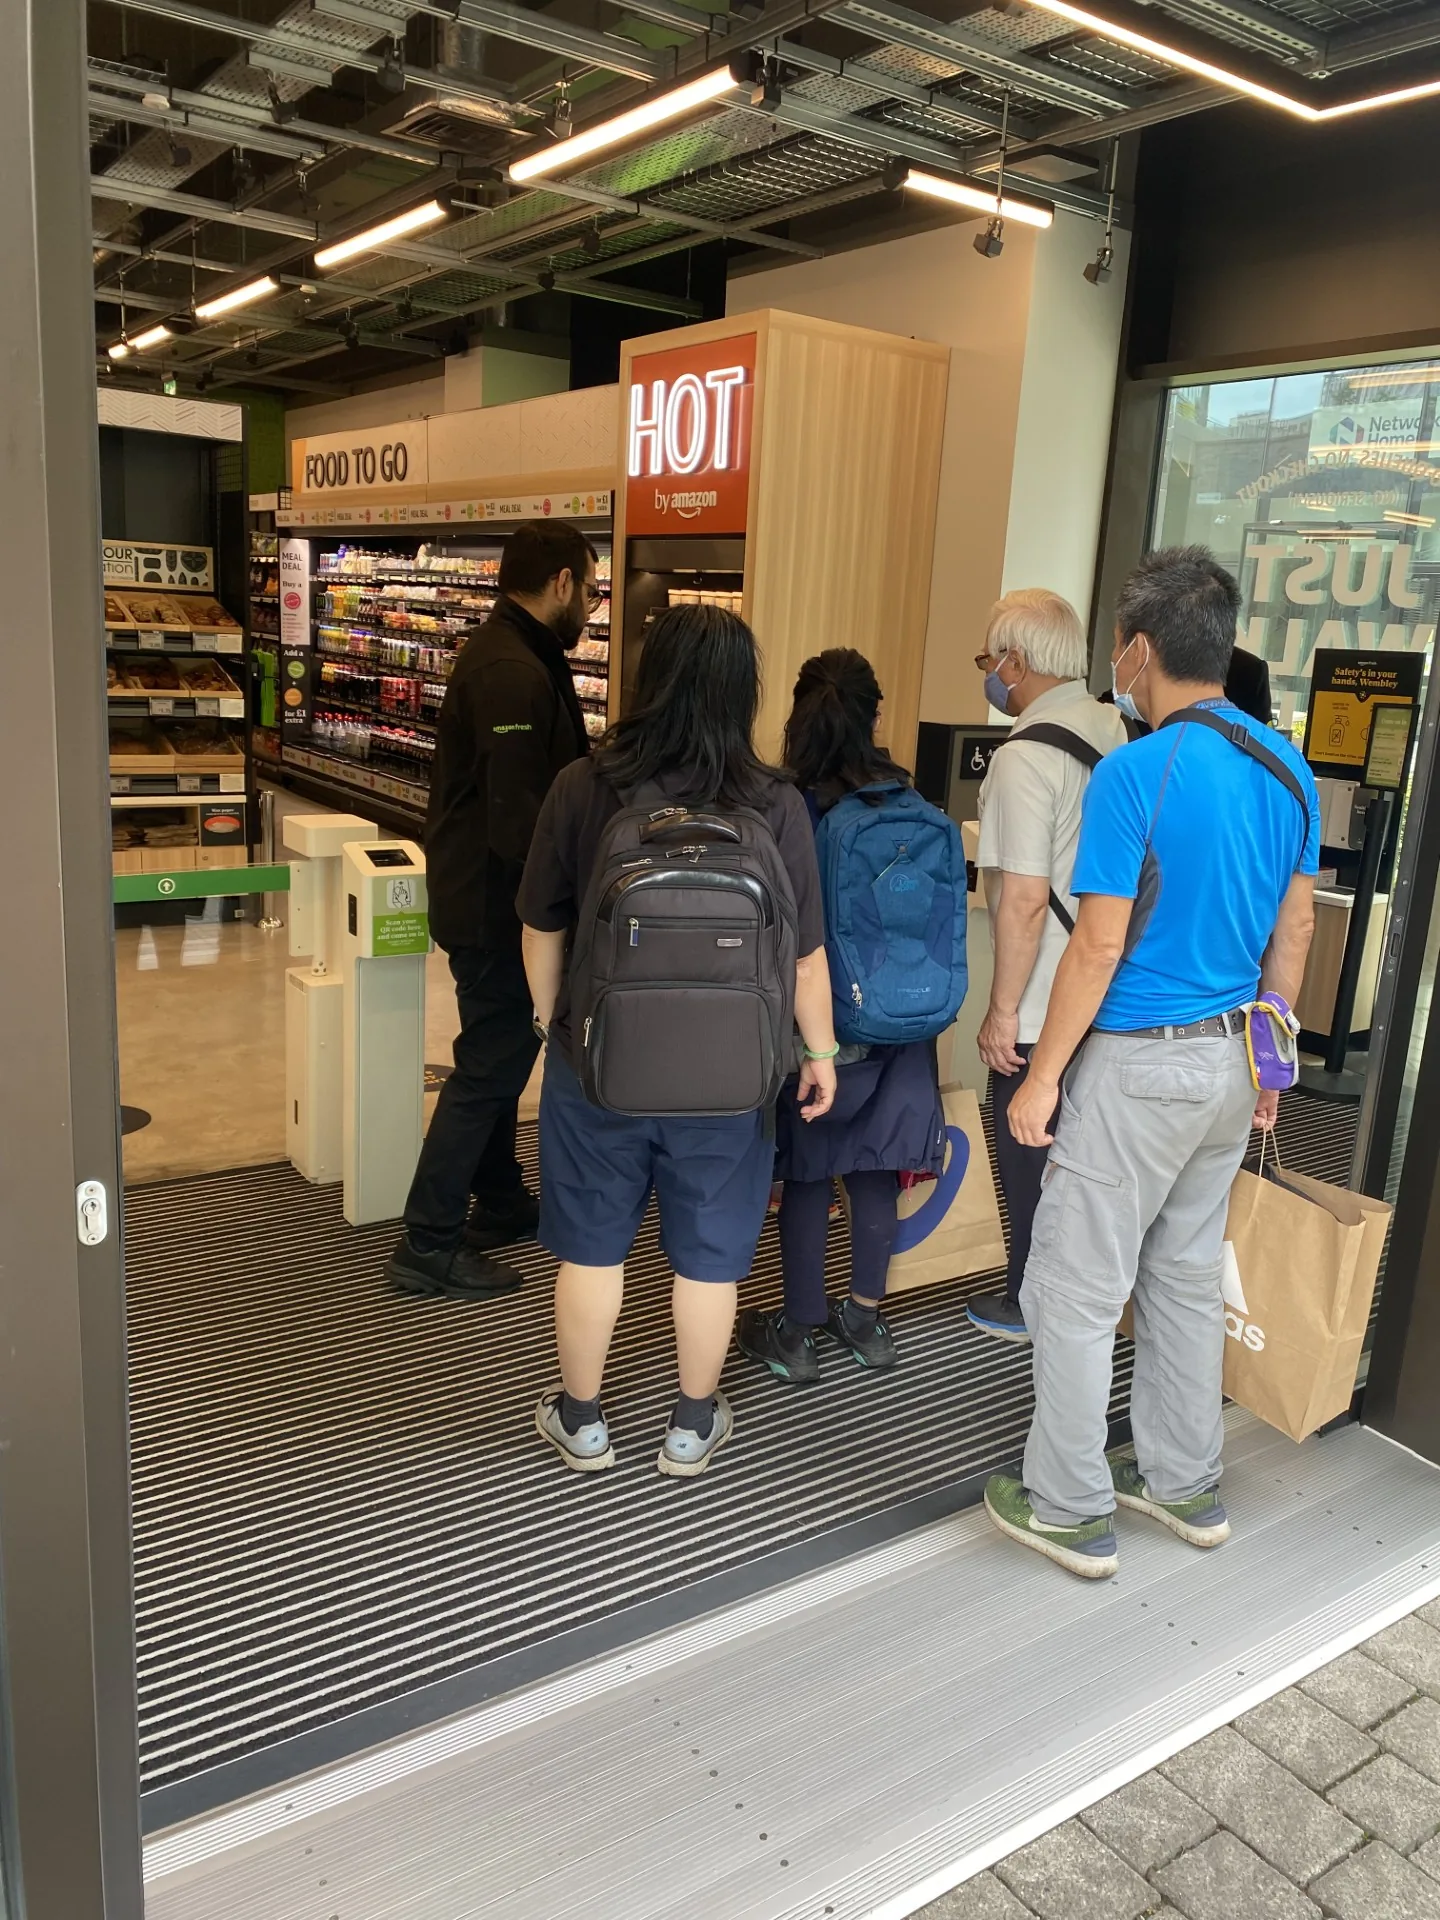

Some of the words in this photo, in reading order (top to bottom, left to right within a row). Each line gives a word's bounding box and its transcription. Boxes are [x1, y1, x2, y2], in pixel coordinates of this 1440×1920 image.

[628, 365, 745, 477] HOT
[305, 450, 349, 489] FOOD
[351, 446, 376, 485] TO
[380, 441, 408, 483] GO
[654, 488, 672, 515] by
[671, 490, 718, 512] amazon
[103, 546, 133, 560] OUR
[281, 552, 304, 562] MEAL
[282, 562, 302, 571] DEAL
[282, 580, 297, 588] Buy
[283, 649, 298, 657] Add
[1334, 667, 1367, 678] Safety's
[1367, 669, 1376, 677] in
[1377, 671, 1398, 680] your
[1331, 676, 1358, 687] hands,
[1359, 678, 1399, 690] Wembley
[296, 708, 307, 718] £1
